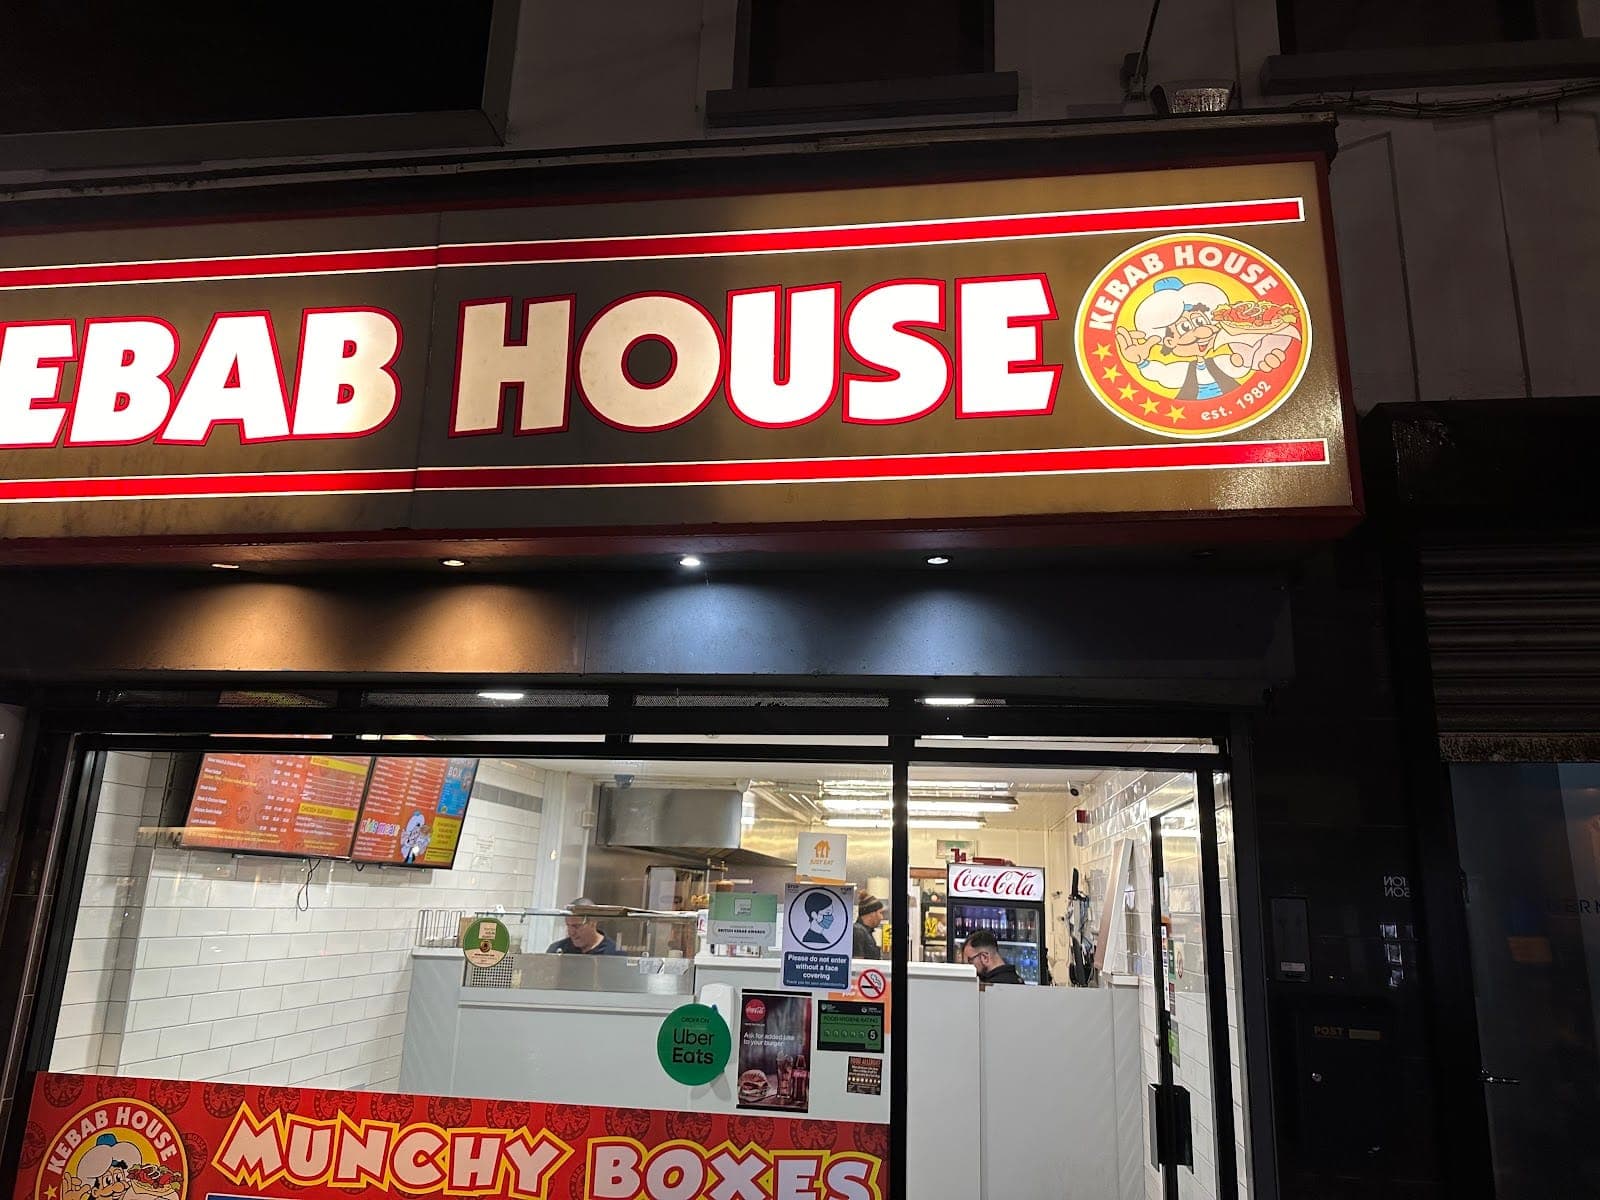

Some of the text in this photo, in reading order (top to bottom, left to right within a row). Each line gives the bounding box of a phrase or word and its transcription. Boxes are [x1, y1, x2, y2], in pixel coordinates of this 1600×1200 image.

[1089, 244, 1279, 331] KEBAB HOUSE
[450, 273, 1063, 435] HOUSE
[1200, 380, 1272, 421] est. 1982
[787, 954, 809, 962] Please
[830, 956, 847, 964] enter
[795, 963, 819, 971] without
[825, 964, 838, 972] face
[802, 972, 830, 980] covering
[673, 1028, 715, 1045] Uber
[743, 1031, 754, 1039] Ask
[869, 1030, 876, 1040] 5
[1313, 1025, 1344, 1036] POST
[764, 1039, 784, 1048] burger
[672, 1047, 714, 1065] Eats
[47, 1106, 178, 1175] KEBAB HOUSE
[216, 1110, 568, 1197] MUNCHY
[588, 1143, 872, 1200] BOXES
